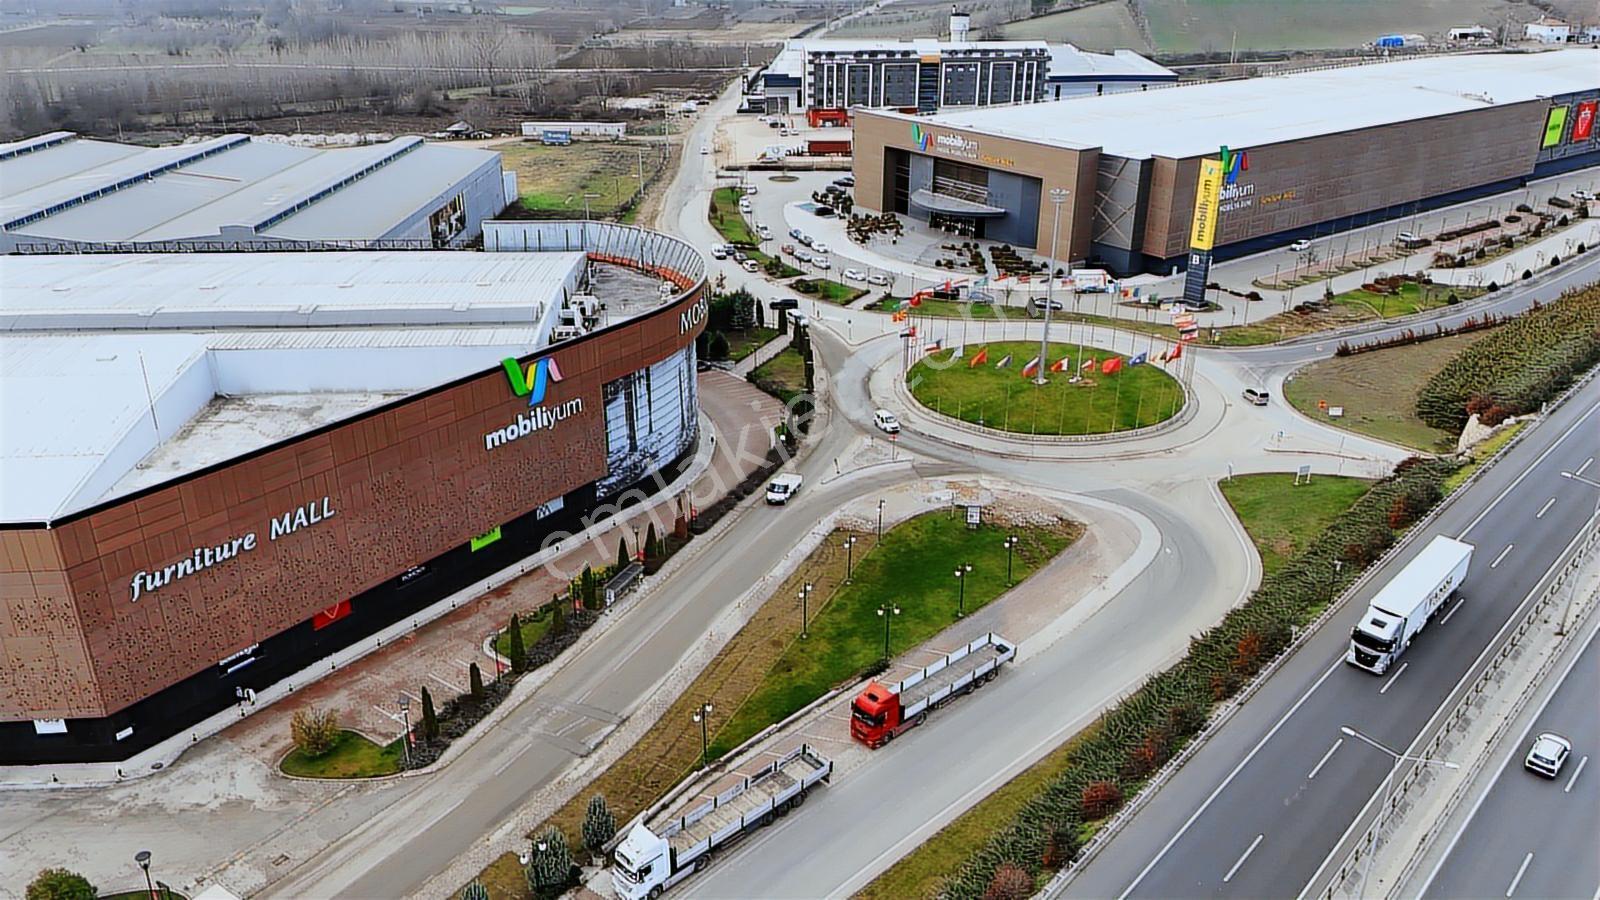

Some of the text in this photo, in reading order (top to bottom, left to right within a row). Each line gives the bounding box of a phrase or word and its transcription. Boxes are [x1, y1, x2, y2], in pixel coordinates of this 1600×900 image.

[1196, 179, 1213, 242] mobiliyum
[1219, 183, 1255, 201] biliyum
[1192, 254, 1200, 265] B
[484, 397, 583, 451] mobiliyum
[130, 495, 336, 603] furniture MALL
